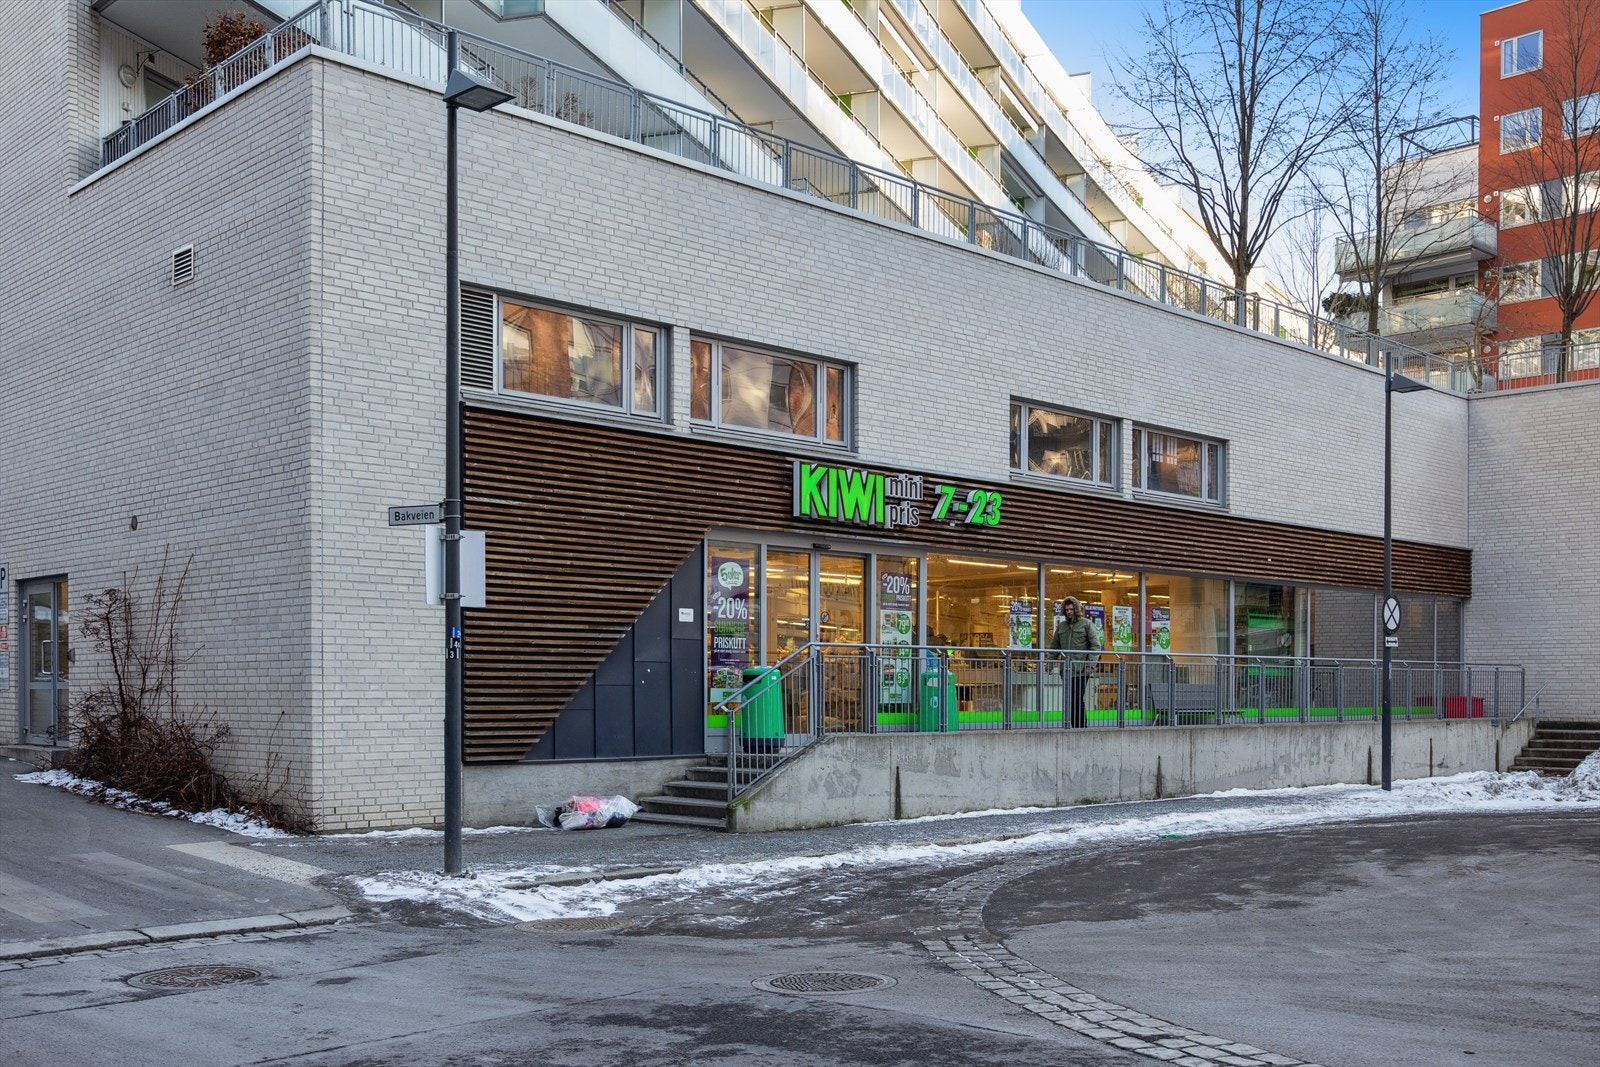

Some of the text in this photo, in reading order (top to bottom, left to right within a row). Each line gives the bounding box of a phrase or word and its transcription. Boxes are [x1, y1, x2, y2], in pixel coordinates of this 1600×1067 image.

[798, 462, 885, 525] KIWI
[889, 474, 923, 500] mini
[394, 510, 435, 521] Bakveien
[889, 501, 920, 528] pris
[935, 484, 1003, 526] 7-23
[882, 575, 910, 595] -20%
[713, 596, 748, 619] -20%
[713, 620, 747, 634] SUNNERE
[713, 636, 747, 649] PRISKUTT
[449, 650, 455, 659] 3
